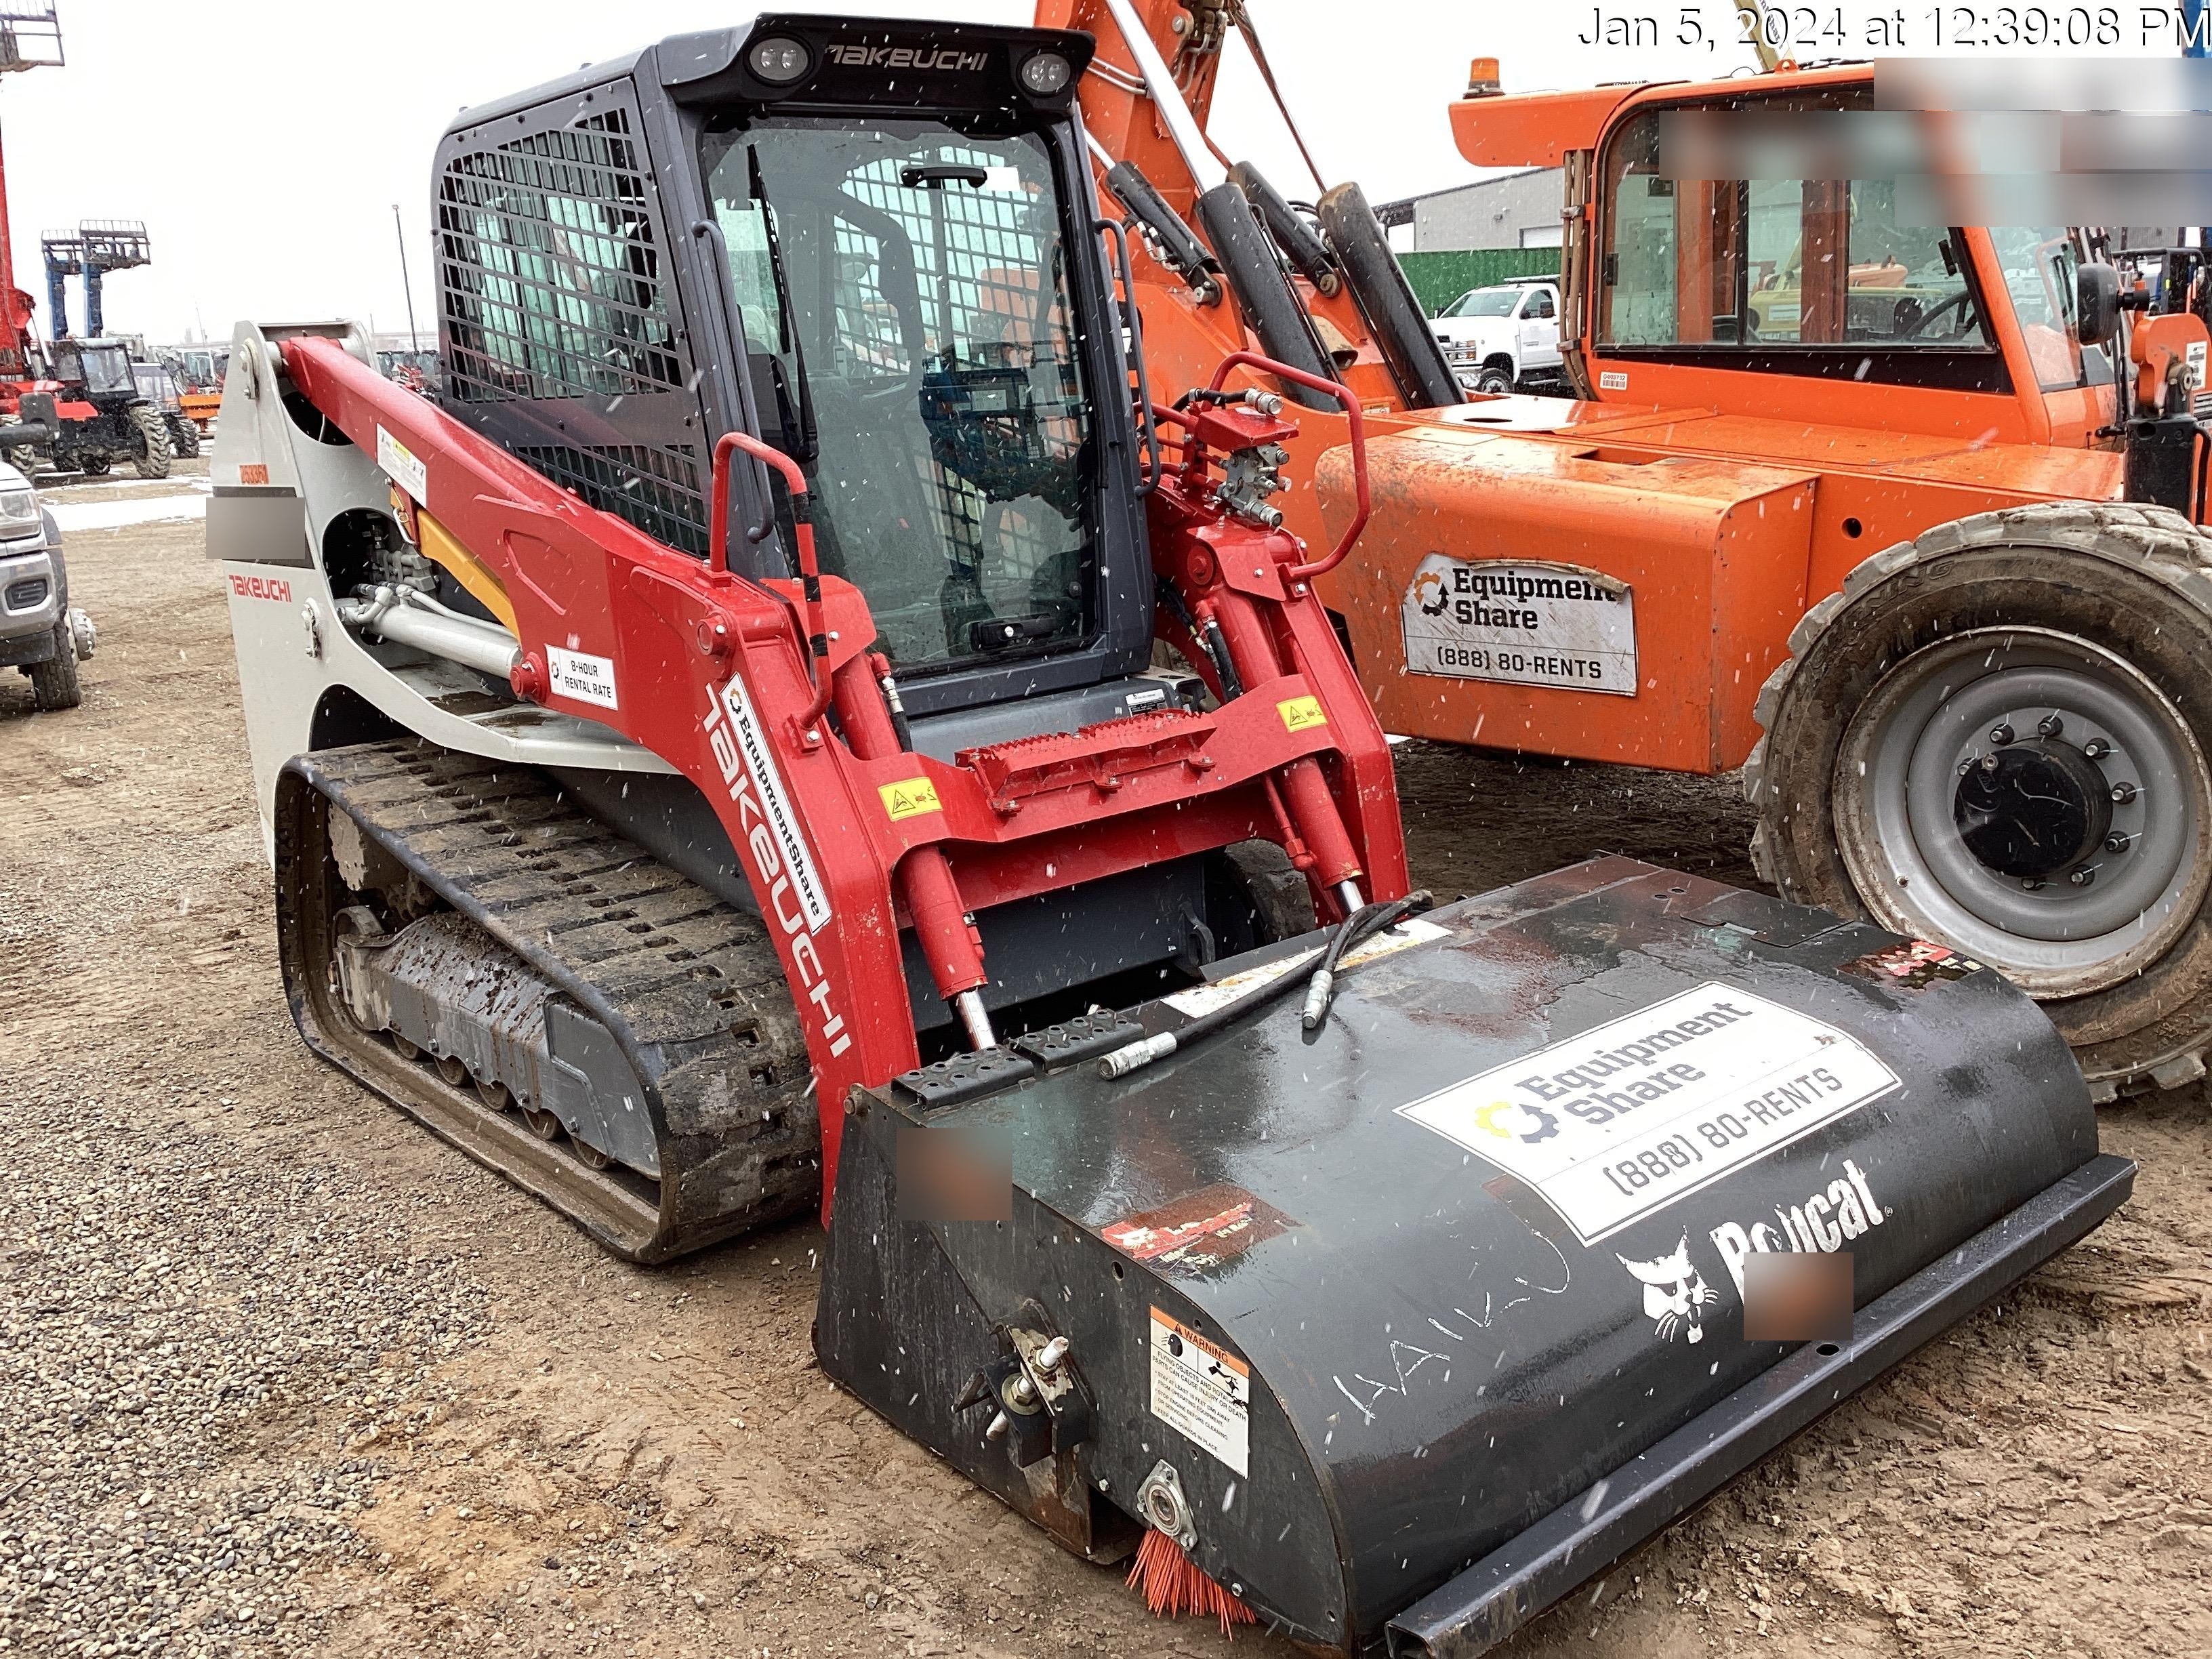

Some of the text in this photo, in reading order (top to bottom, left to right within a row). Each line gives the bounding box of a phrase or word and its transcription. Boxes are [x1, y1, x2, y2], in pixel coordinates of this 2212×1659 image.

[1454, 600, 1538, 630] Share
[571, 660, 598, 677] 8-HOUR
[1437, 646, 1601, 678] (888) 80-RENTS
[565, 676, 611, 699] RENTAL RATE
[738, 713, 820, 917] EquipmentShare
[1514, 1002, 1755, 1101] Equipment
[1563, 1062, 1706, 1125] Share
[1602, 1067, 1843, 1196] (888) 80-RENTS
[1184, 1328, 1229, 1364] WARNING
[1152, 1354, 1246, 1422] PARTS CAN CAUSE INJURY OR DEATH
[1158, 1350, 1174, 1366] FLYING
[1176, 1362, 1199, 1382] OBJECTS
[1200, 1378, 1210, 1391] AND
[1158, 1378, 1170, 1391] FROM
[1170, 1387, 1195, 1409] OPERATING
[1158, 1371, 1168, 1382] STAY
[1168, 1378, 1173, 1386] AT
[1174, 1382, 1188, 1395] LEAST
[1195, 1396, 1206, 1408] FEET
[1216, 1410, 1229, 1424] AWAY
[1158, 1389, 1168, 1401] STOP
[1204, 1420, 1227, 1441] CLEANING
